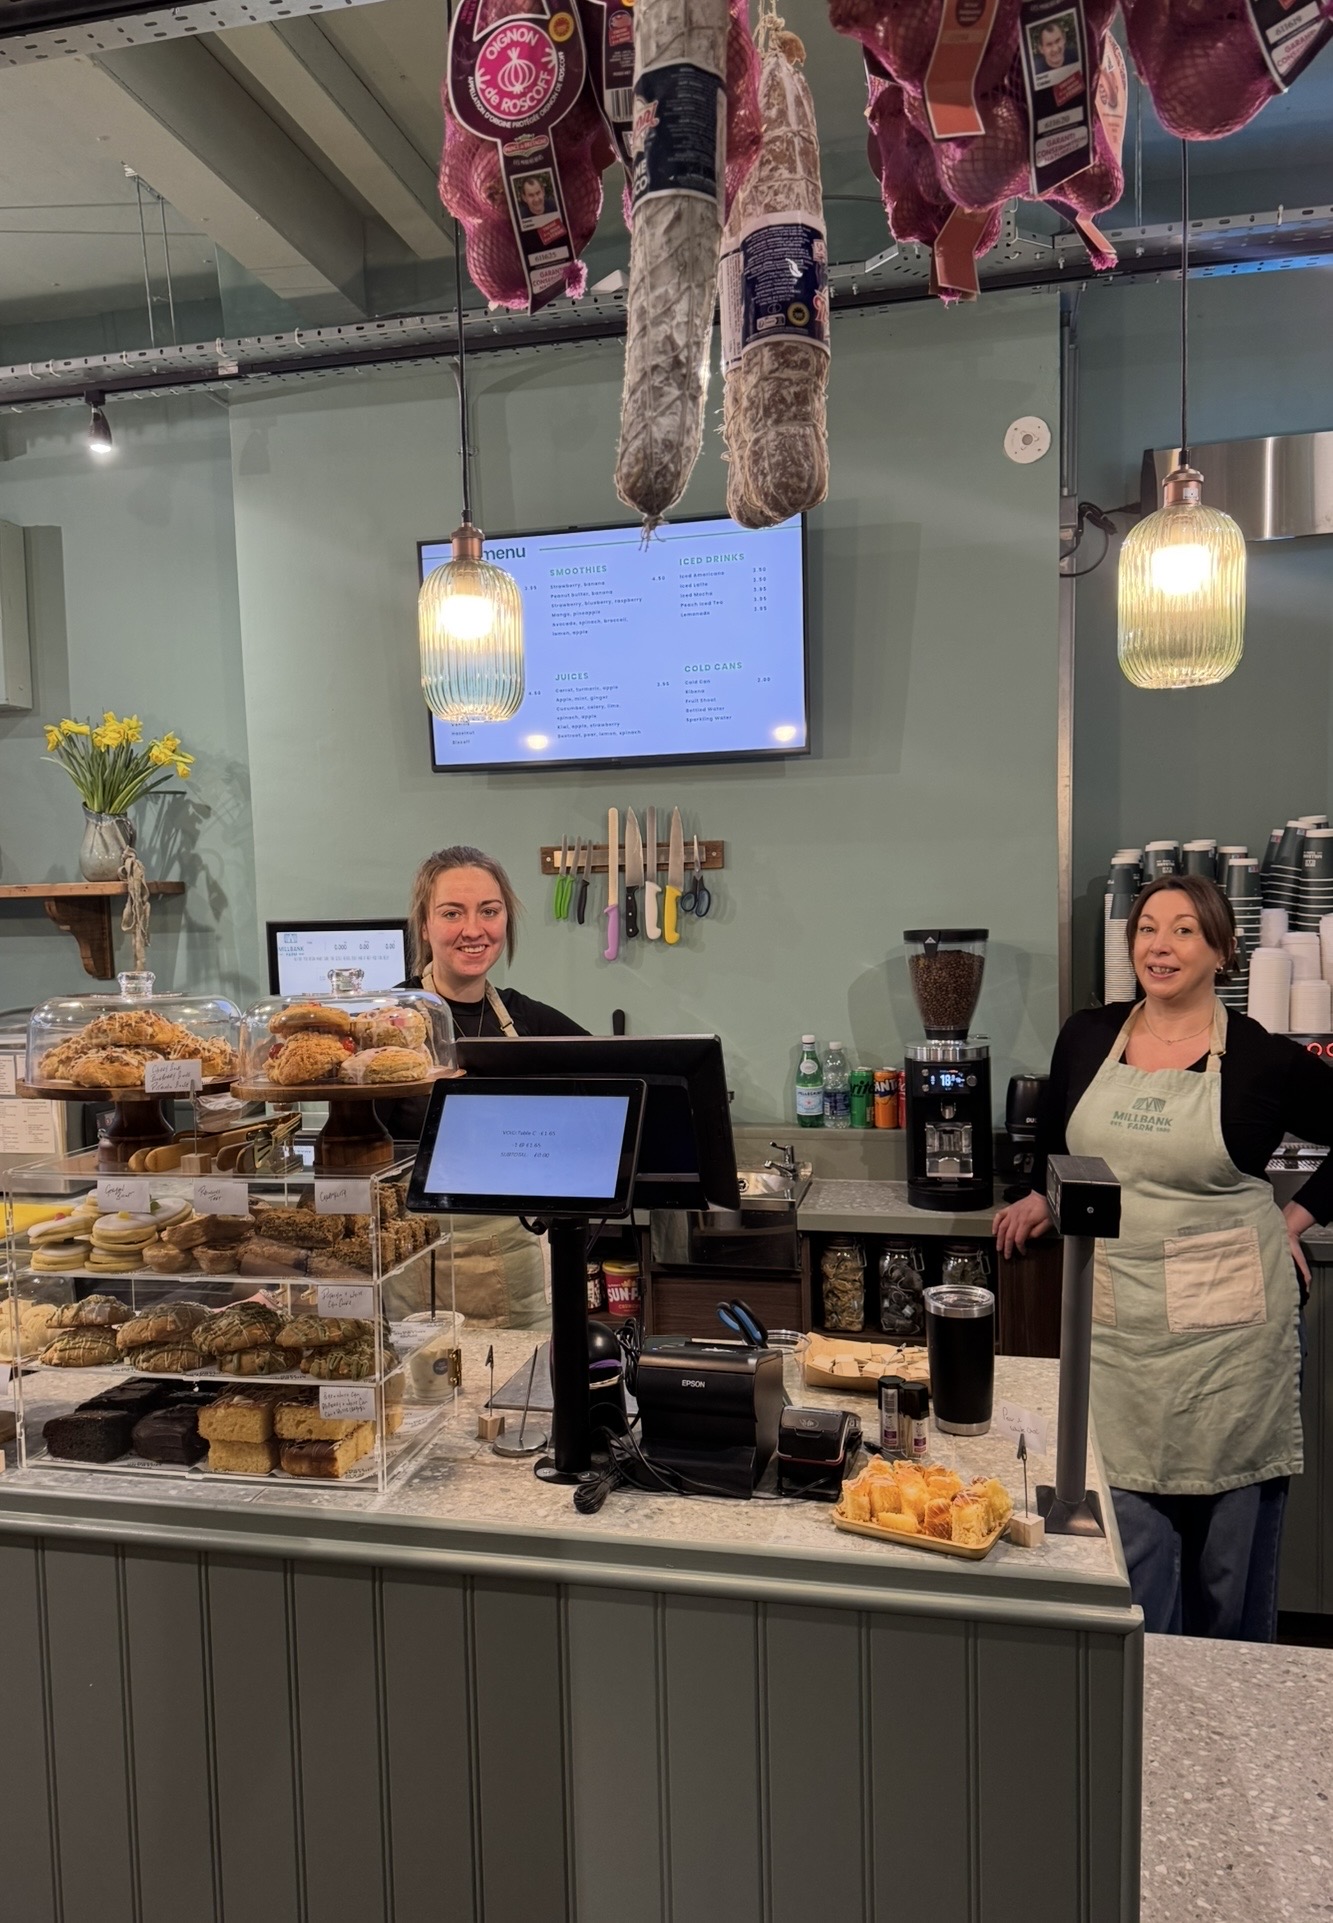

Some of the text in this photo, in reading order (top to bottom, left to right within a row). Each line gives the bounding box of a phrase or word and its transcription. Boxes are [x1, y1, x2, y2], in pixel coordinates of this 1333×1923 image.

[486, 28, 539, 60] OIGNON
[485, 70, 551, 113] de ROSCOFF
[468, 76, 486, 115] APPELLATION
[484, 112, 512, 129] D'ORIGINE
[540, 94, 557, 116] OIGNON
[482, 547, 526, 561] menu
[679, 553, 745, 566] ICED DRINKS
[549, 565, 607, 577] SMOOTHIES
[684, 662, 743, 673] COLD CANS
[555, 672, 589, 681] JUICES
[874, 1079, 897, 1093] ANT
[1113, 1111, 1173, 1127] MILLBANK
[1127, 1122, 1153, 1132] FARM
[681, 1379, 705, 1388] EPSON
